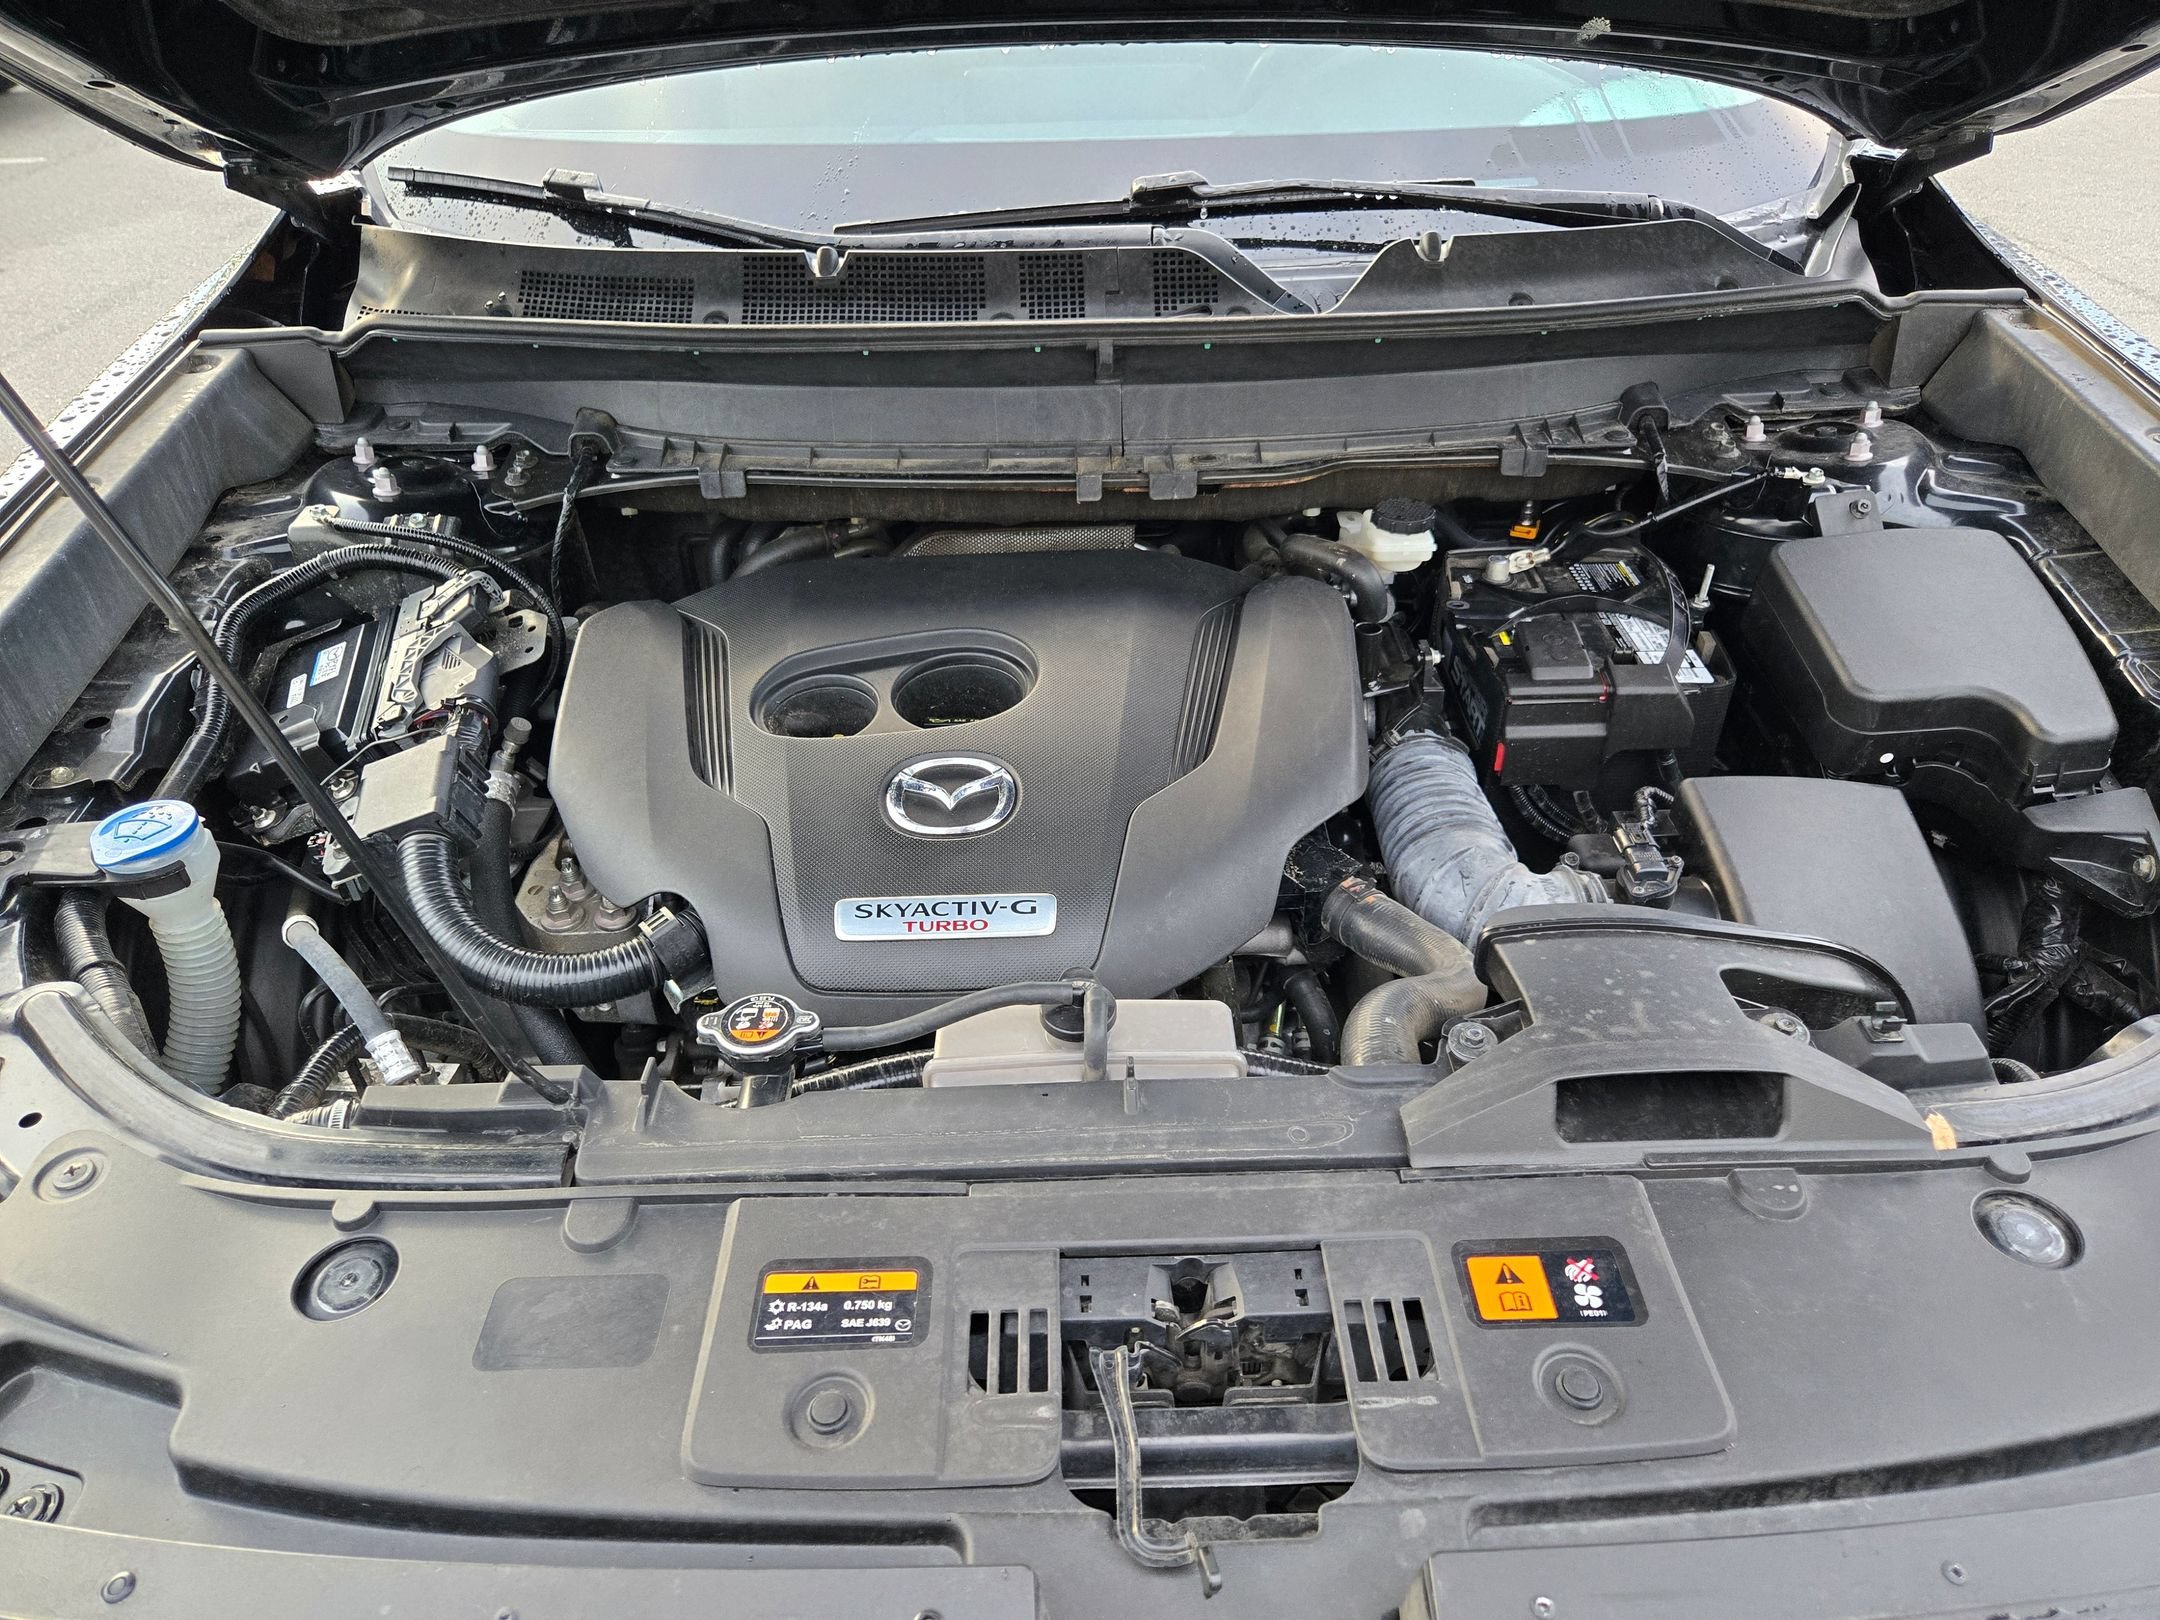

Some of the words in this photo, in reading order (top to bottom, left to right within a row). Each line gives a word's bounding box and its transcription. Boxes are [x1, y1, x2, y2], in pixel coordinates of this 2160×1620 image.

[854, 899, 1037, 919] SKYACTIV-G
[902, 919, 989, 933] TURBO
[786, 1301, 829, 1312] R-134a
[843, 1300, 875, 1311] 0.750
[877, 1300, 893, 1312] kg
[783, 1318, 812, 1330] PAG
[840, 1317, 865, 1328] SAE
